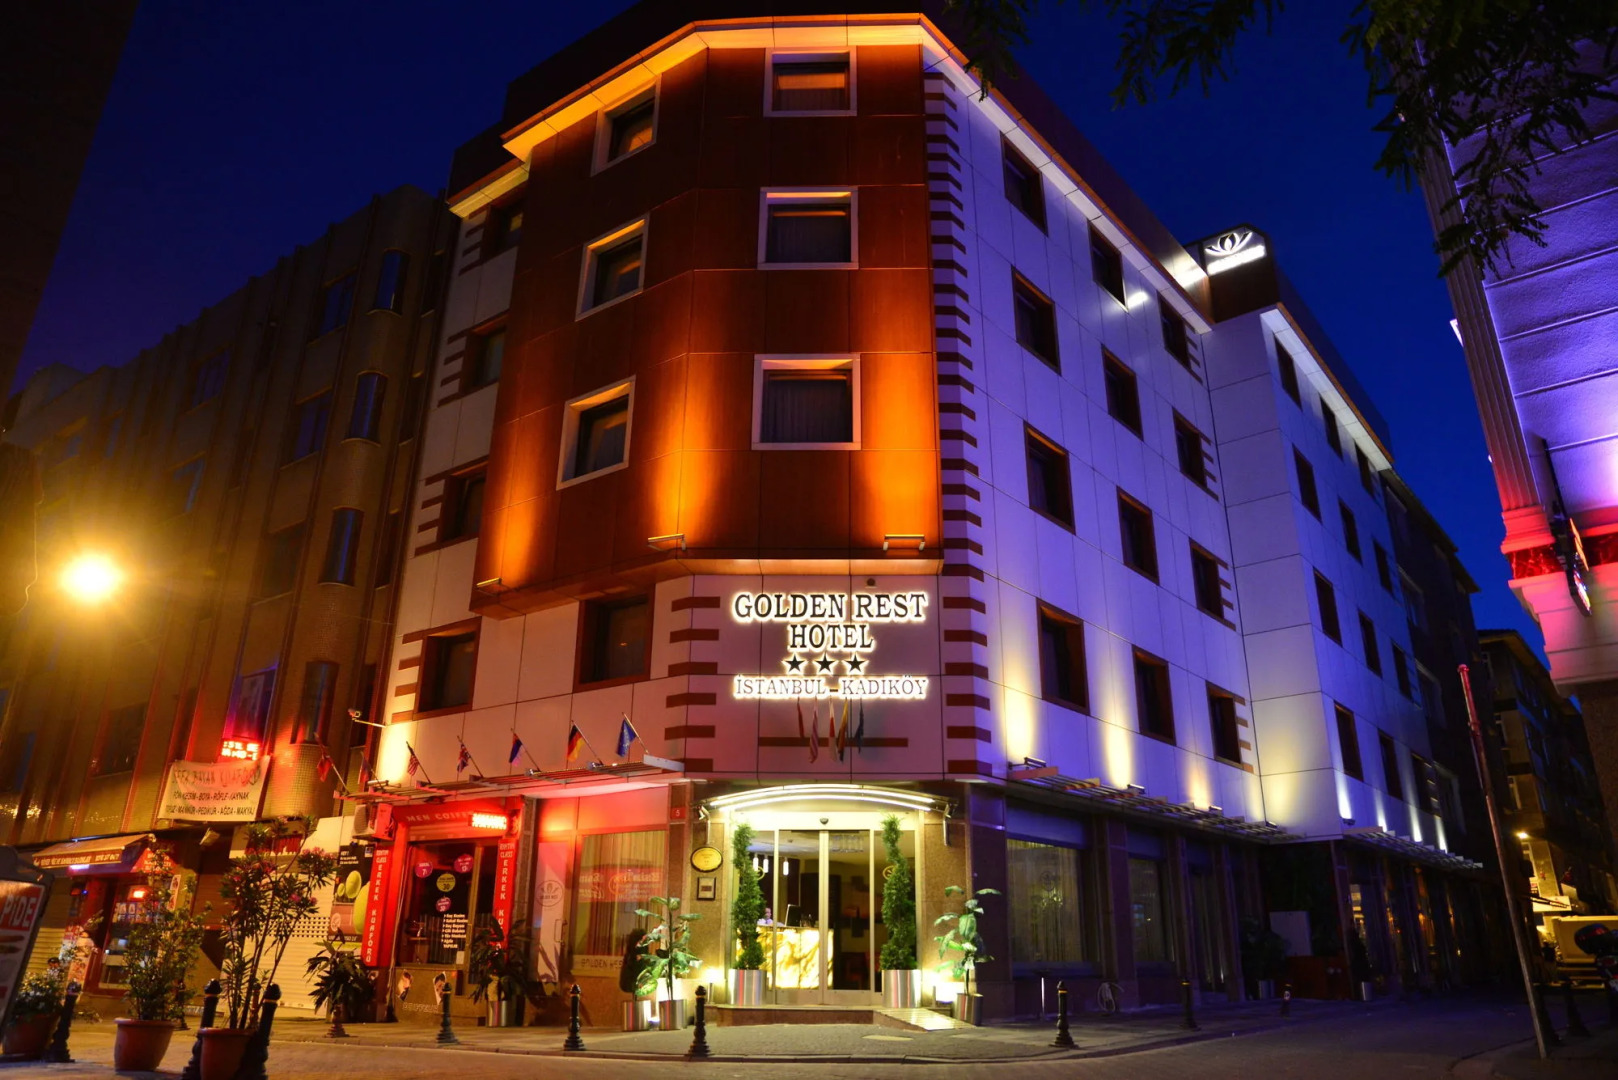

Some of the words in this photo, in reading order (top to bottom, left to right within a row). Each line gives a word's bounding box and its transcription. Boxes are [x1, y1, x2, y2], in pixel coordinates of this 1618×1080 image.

[734, 593, 846, 619] GOLDEN
[855, 593, 926, 619] REST
[789, 624, 874, 649] HOTEL
[736, 674, 827, 695] İSTANBUL
[841, 674, 927, 695] KADIKÖY
[500, 859, 508, 900] ERKEK
